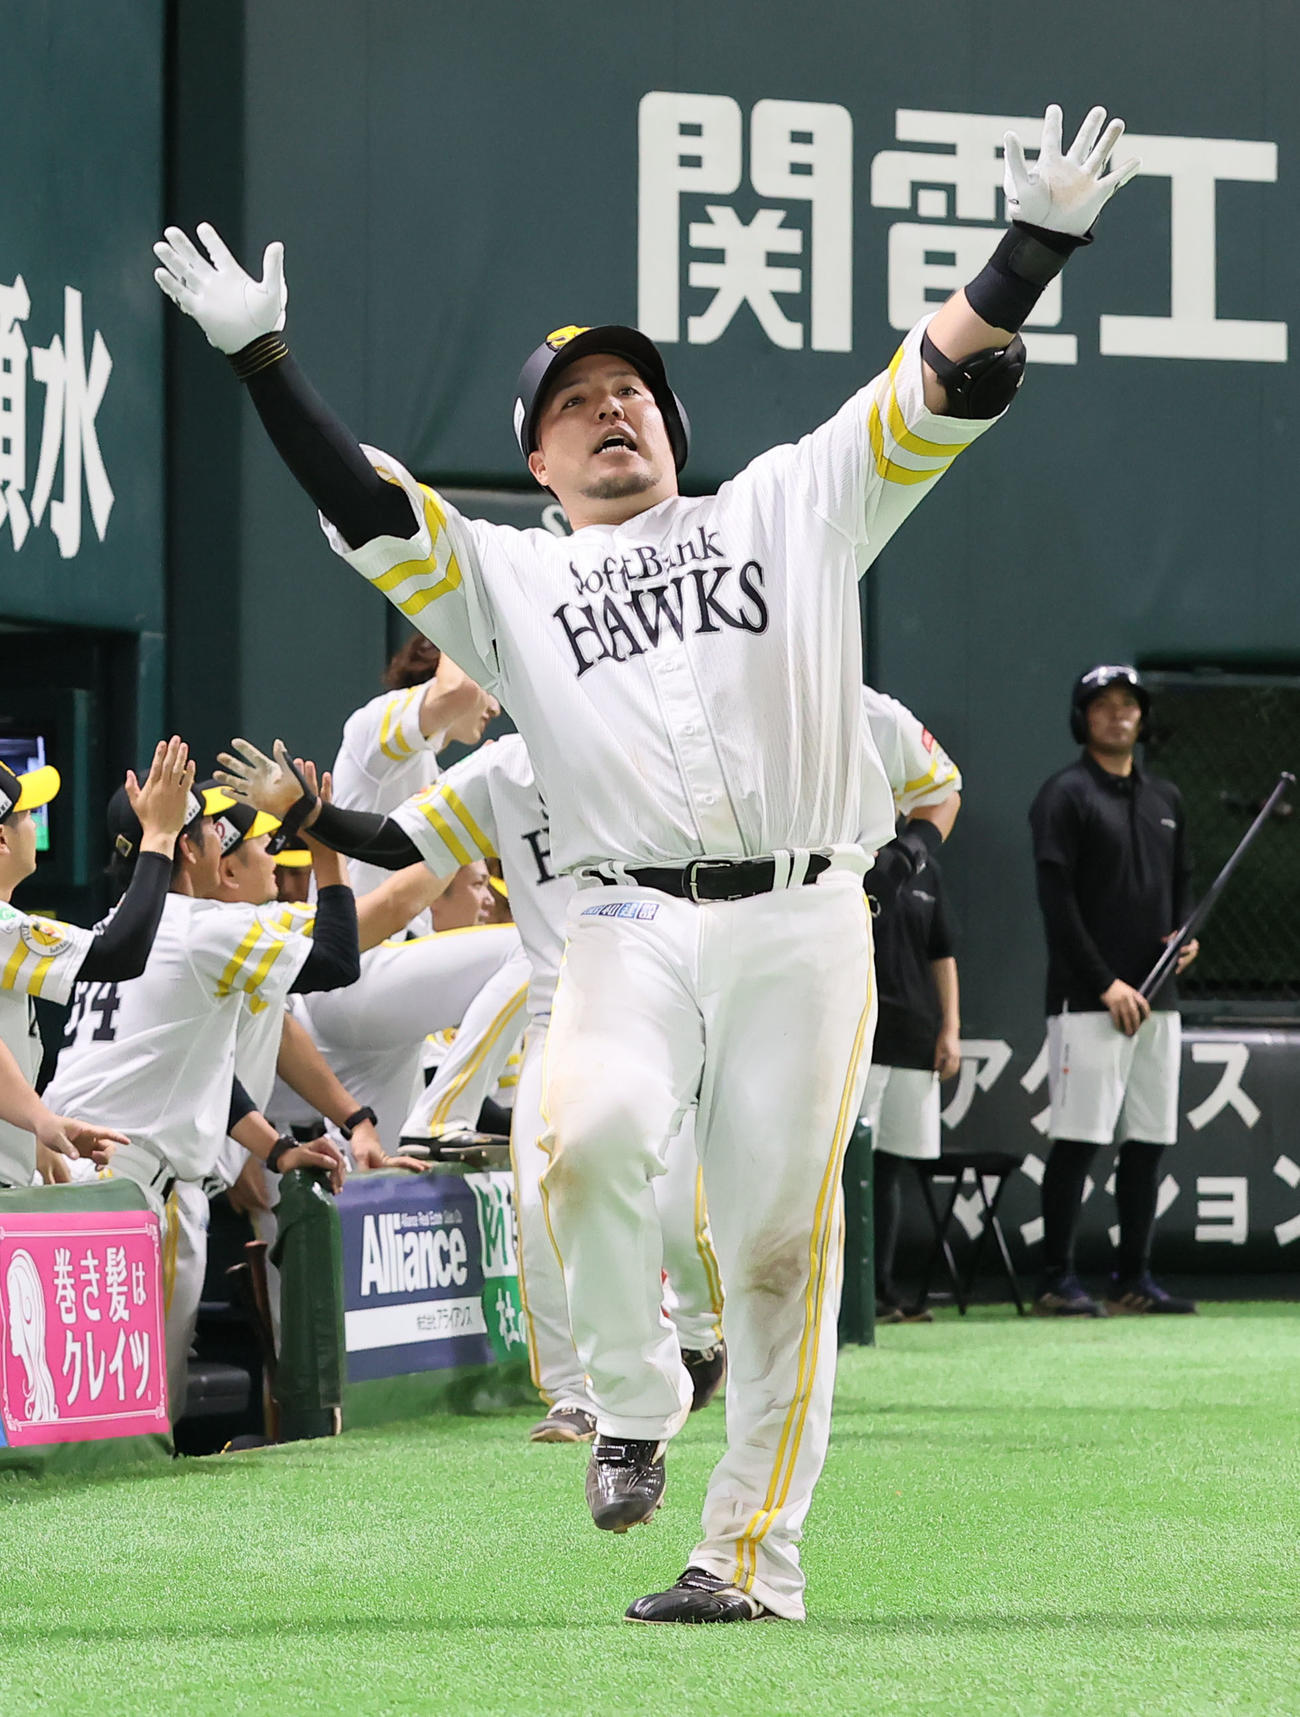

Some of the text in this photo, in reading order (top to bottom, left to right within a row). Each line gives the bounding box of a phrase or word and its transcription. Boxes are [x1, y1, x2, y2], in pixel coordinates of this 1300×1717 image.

[638, 91, 1287, 364] 関電工
[553, 561, 769, 678] HAWKS
[53, 1246, 147, 1325] 巻き髪は
[361, 1212, 468, 1297] Alliance
